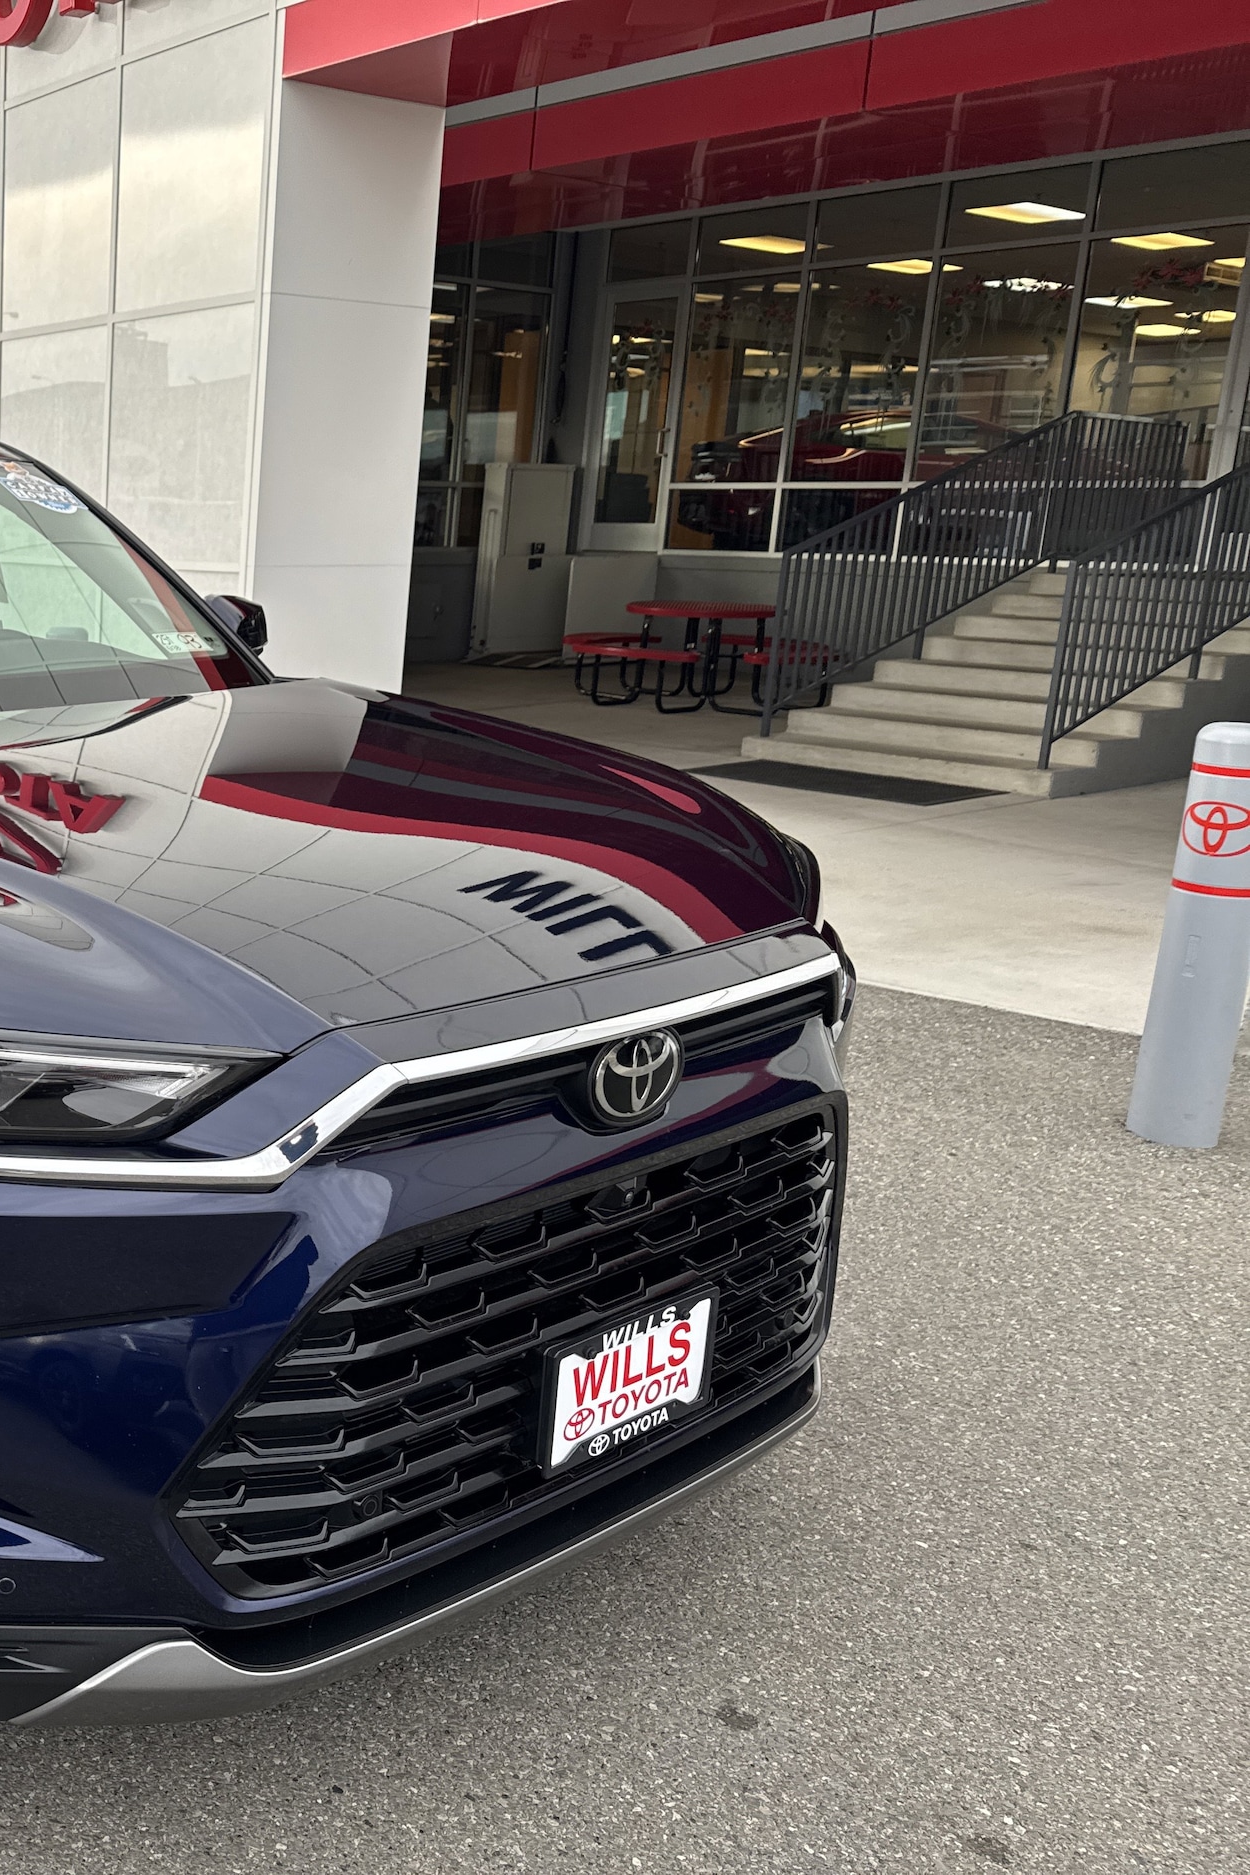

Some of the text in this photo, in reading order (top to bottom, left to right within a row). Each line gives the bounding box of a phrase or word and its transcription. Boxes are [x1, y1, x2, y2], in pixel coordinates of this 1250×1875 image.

[602, 1306, 677, 1351] WILLS
[573, 1322, 691, 1407] WILLS
[598, 1368, 689, 1425] TOYOTA
[613, 1407, 669, 1444] TOYOTA
